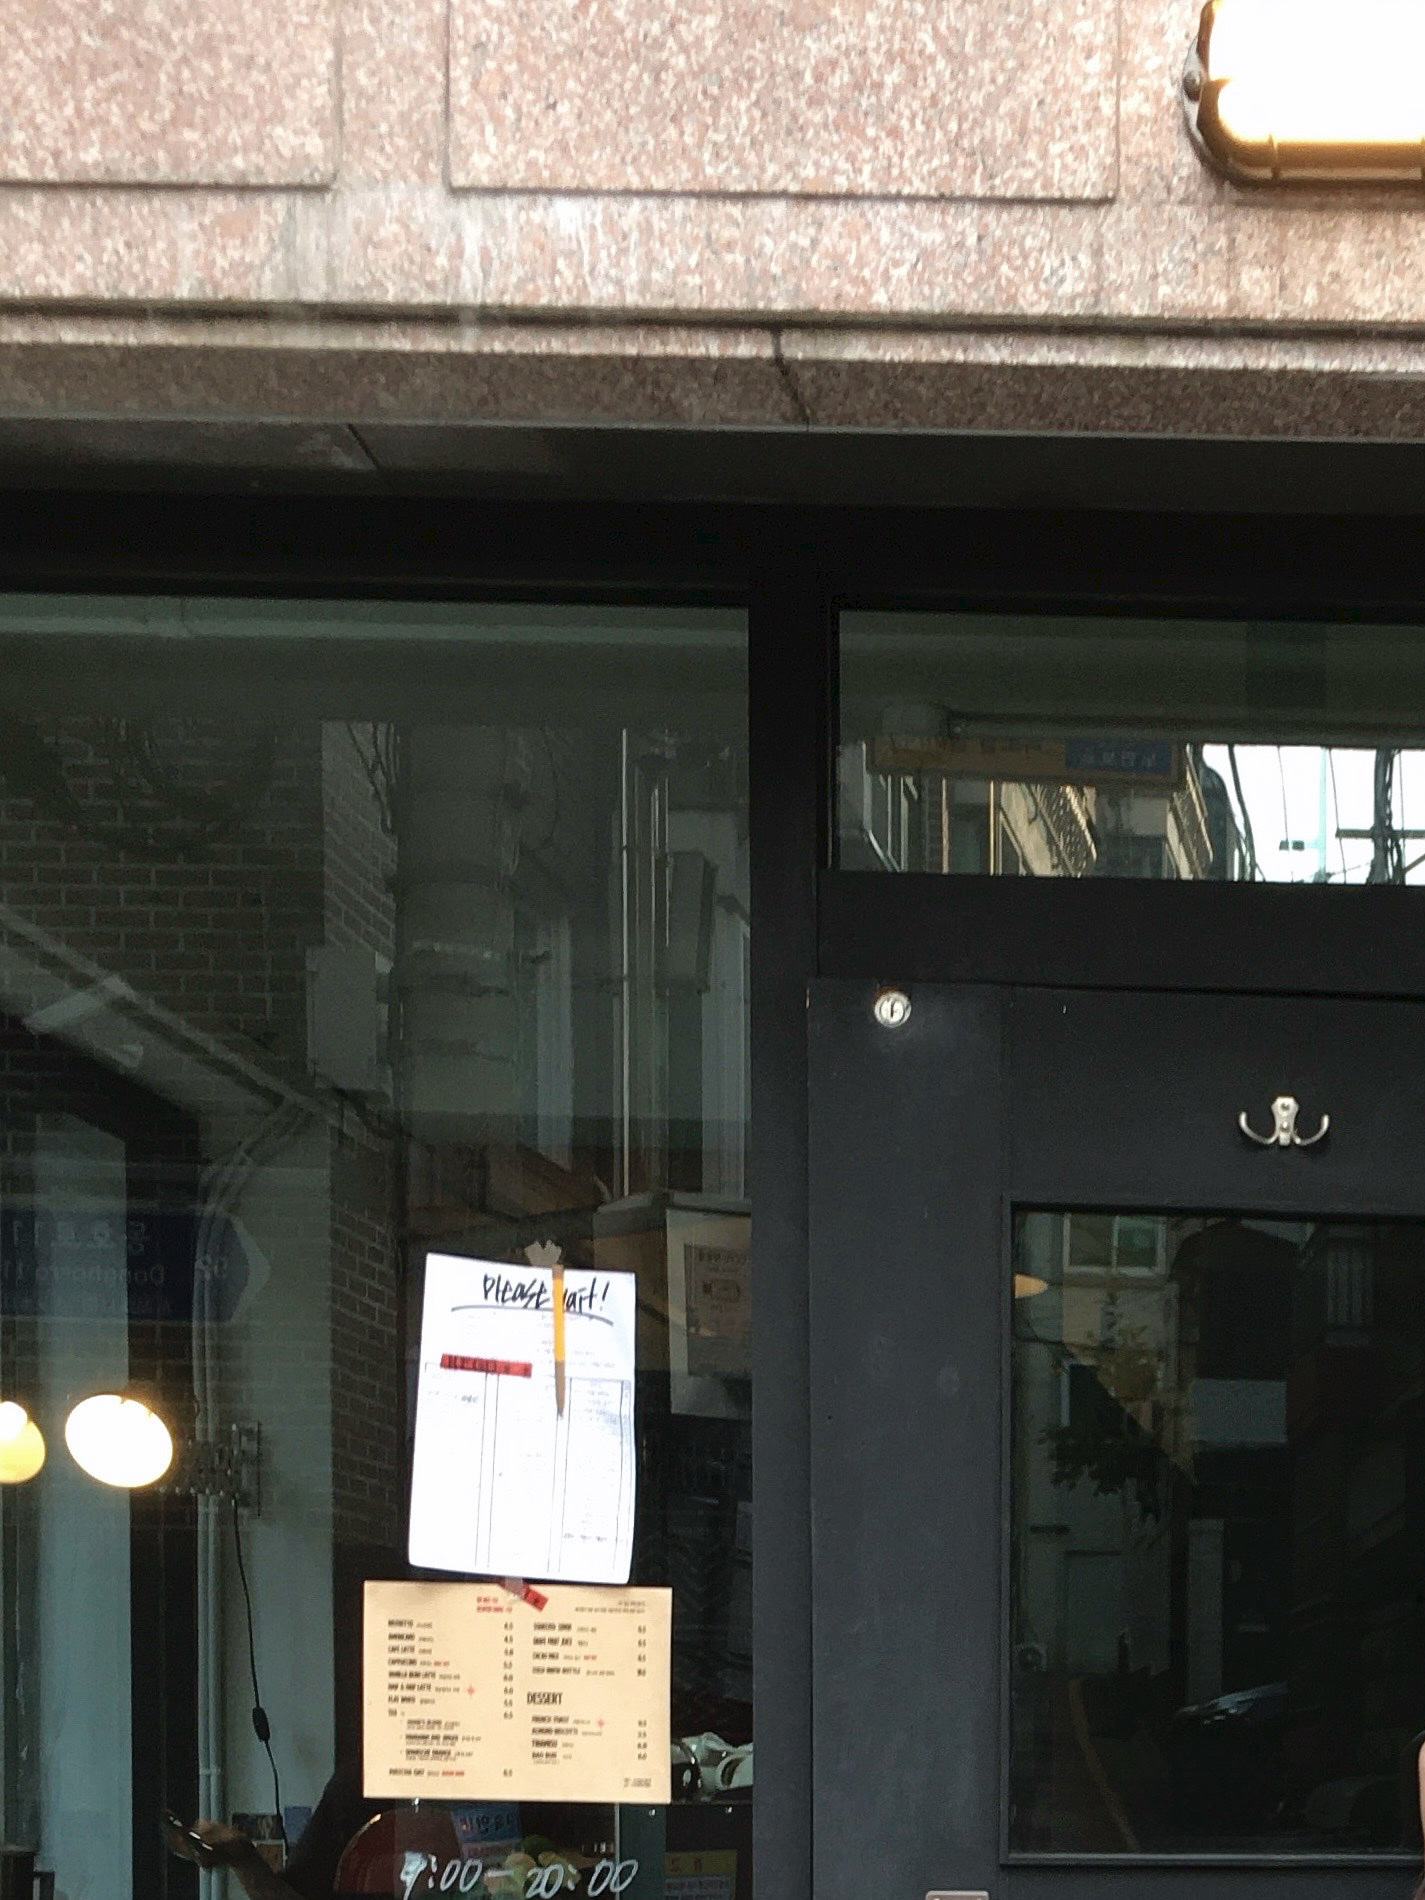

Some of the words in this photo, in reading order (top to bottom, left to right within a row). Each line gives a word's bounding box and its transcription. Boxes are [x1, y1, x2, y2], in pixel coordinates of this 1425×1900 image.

[483, 1273, 551, 1310] Please
[561, 1276, 610, 1315] ait!
[526, 1691, 563, 1705] DESSERT
